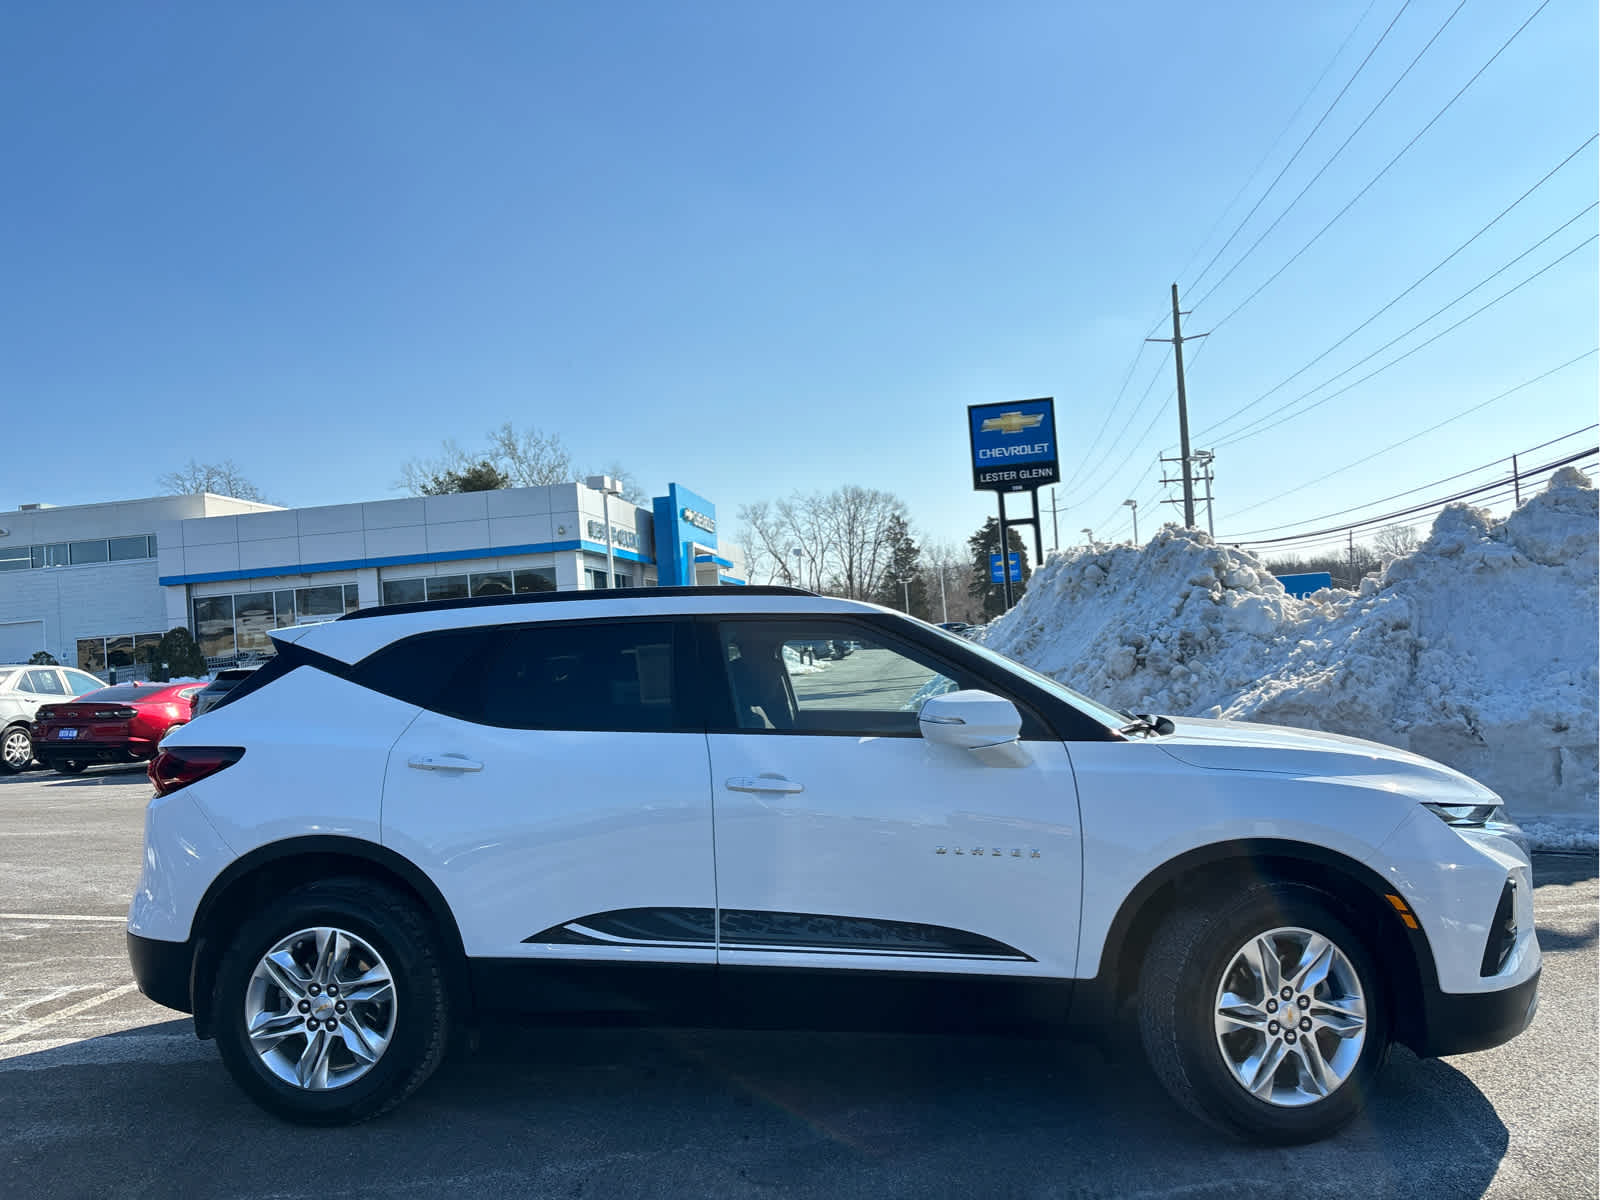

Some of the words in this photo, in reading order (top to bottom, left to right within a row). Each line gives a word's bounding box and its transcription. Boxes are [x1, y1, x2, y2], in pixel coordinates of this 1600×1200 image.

[979, 442, 1049, 459] CHEVROLET
[980, 470, 1017, 483] LESTER
[1019, 467, 1053, 480] GLENN
